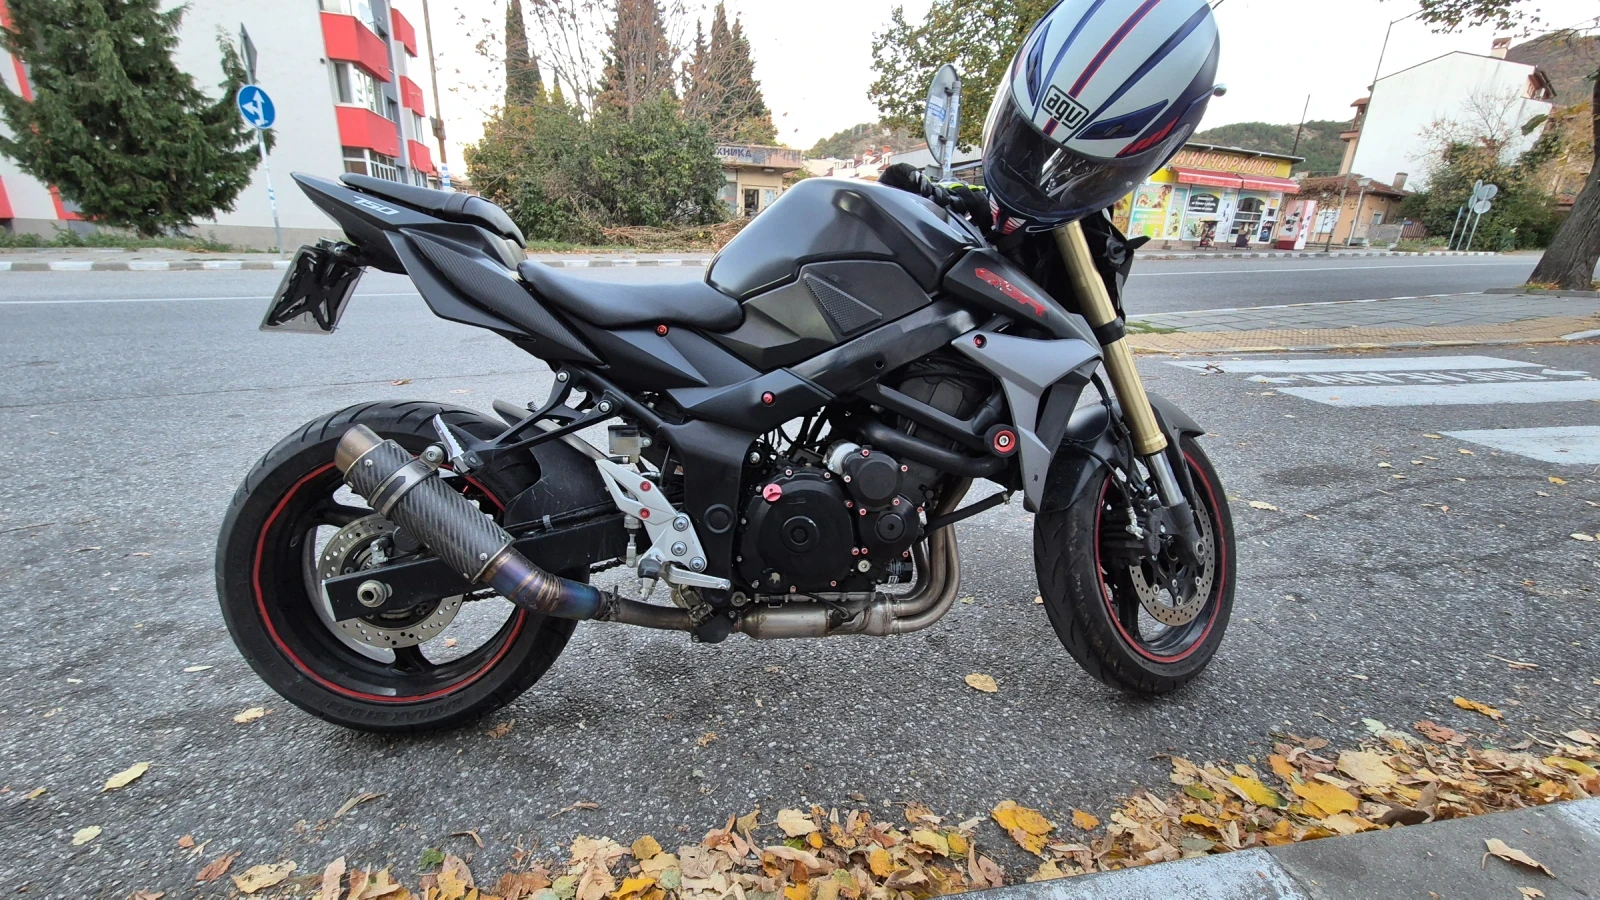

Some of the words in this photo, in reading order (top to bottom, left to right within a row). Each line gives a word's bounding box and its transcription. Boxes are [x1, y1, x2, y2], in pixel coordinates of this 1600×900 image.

[1045, 92, 1083, 125] agv
[1168, 149, 1277, 175] АНИЧАРНИЦА
[353, 195, 400, 215] 750
